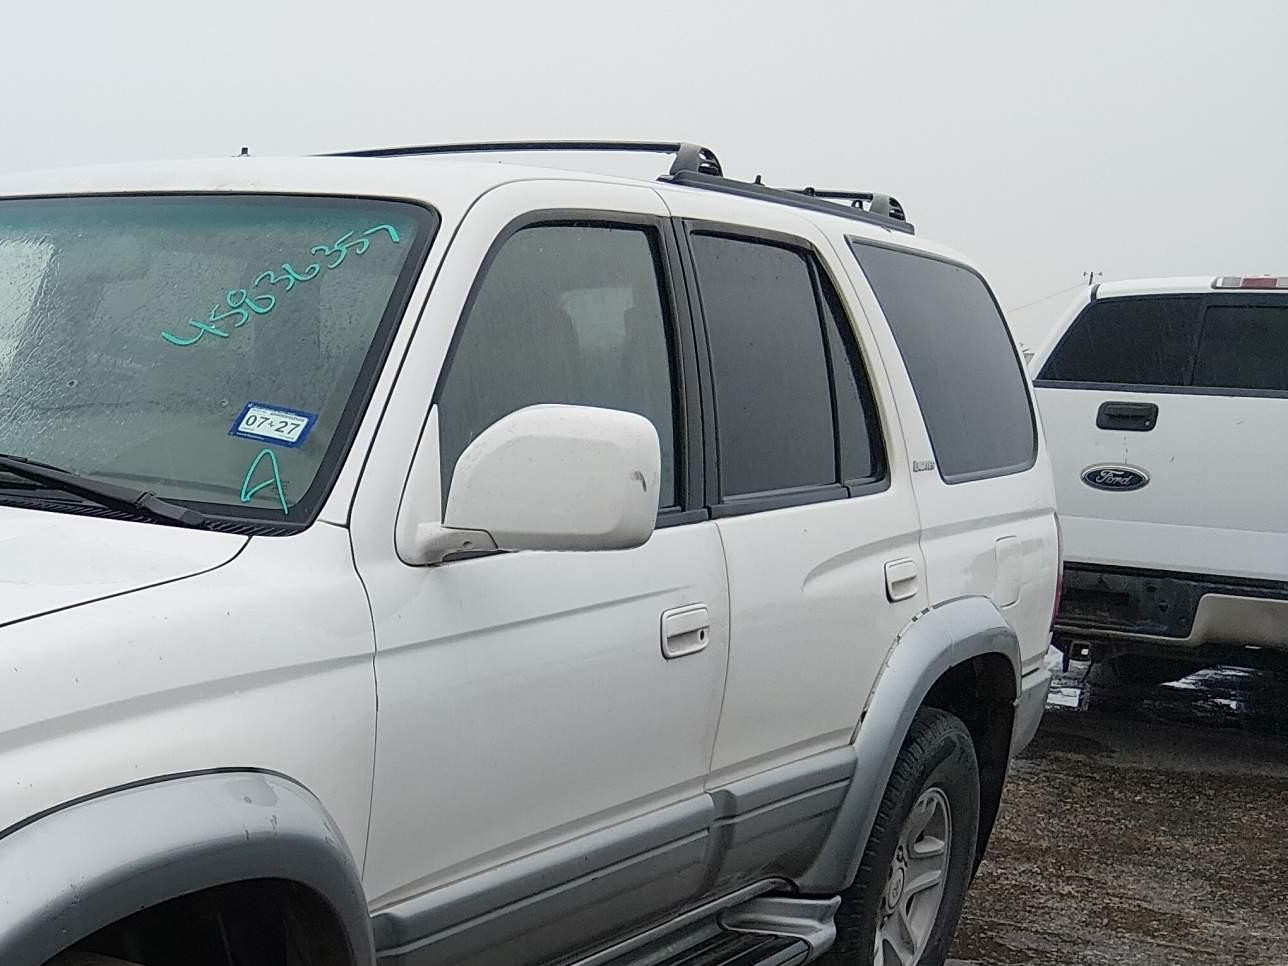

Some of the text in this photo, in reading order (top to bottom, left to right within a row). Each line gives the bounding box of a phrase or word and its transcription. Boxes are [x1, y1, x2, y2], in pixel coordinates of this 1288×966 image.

[160, 223, 402, 346] 45836357
[245, 414, 270, 429] 07
[274, 420, 301, 435] 27
[239, 447, 289, 514] A
[1095, 469, 1133, 485] Ford
